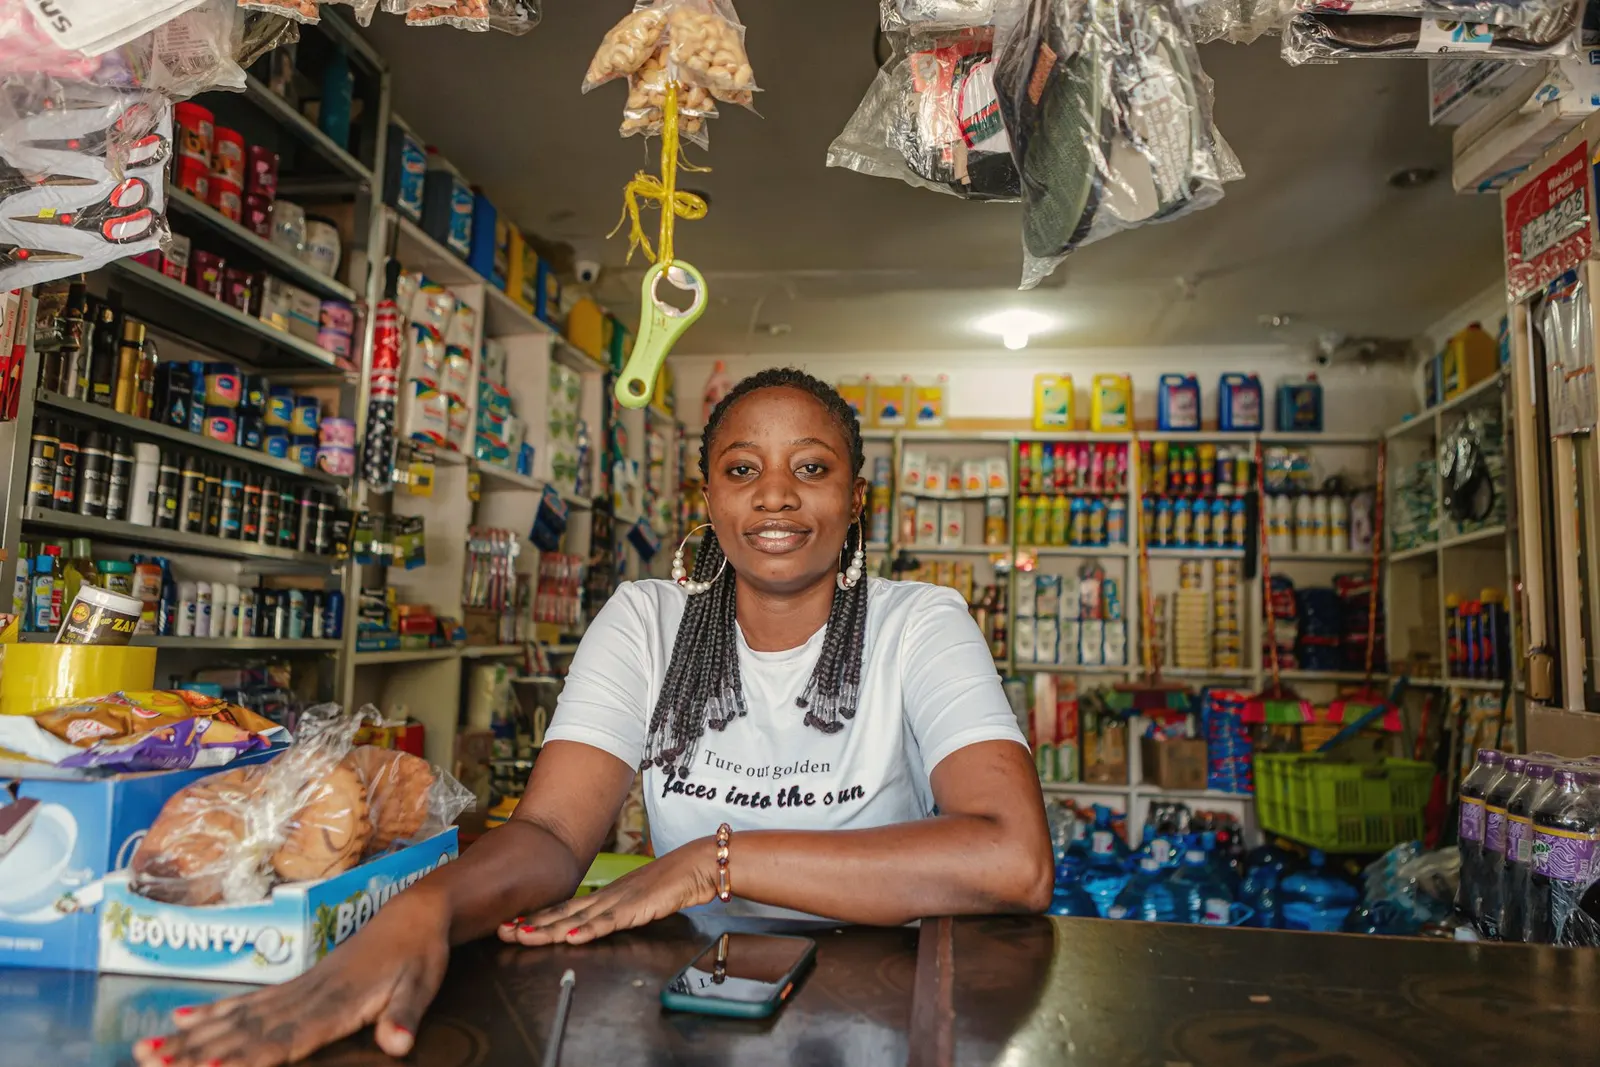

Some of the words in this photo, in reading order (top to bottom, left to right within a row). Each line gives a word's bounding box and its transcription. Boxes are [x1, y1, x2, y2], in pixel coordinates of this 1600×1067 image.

[704, 749, 742, 774] Ture
[746, 765, 770, 778] our
[772, 759, 831, 780] golden
[661, 770, 717, 800] faces
[725, 785, 772, 810] into
[777, 784, 816, 808] the
[822, 784, 865, 806] sun
[129, 914, 249, 954] BOUNTY
